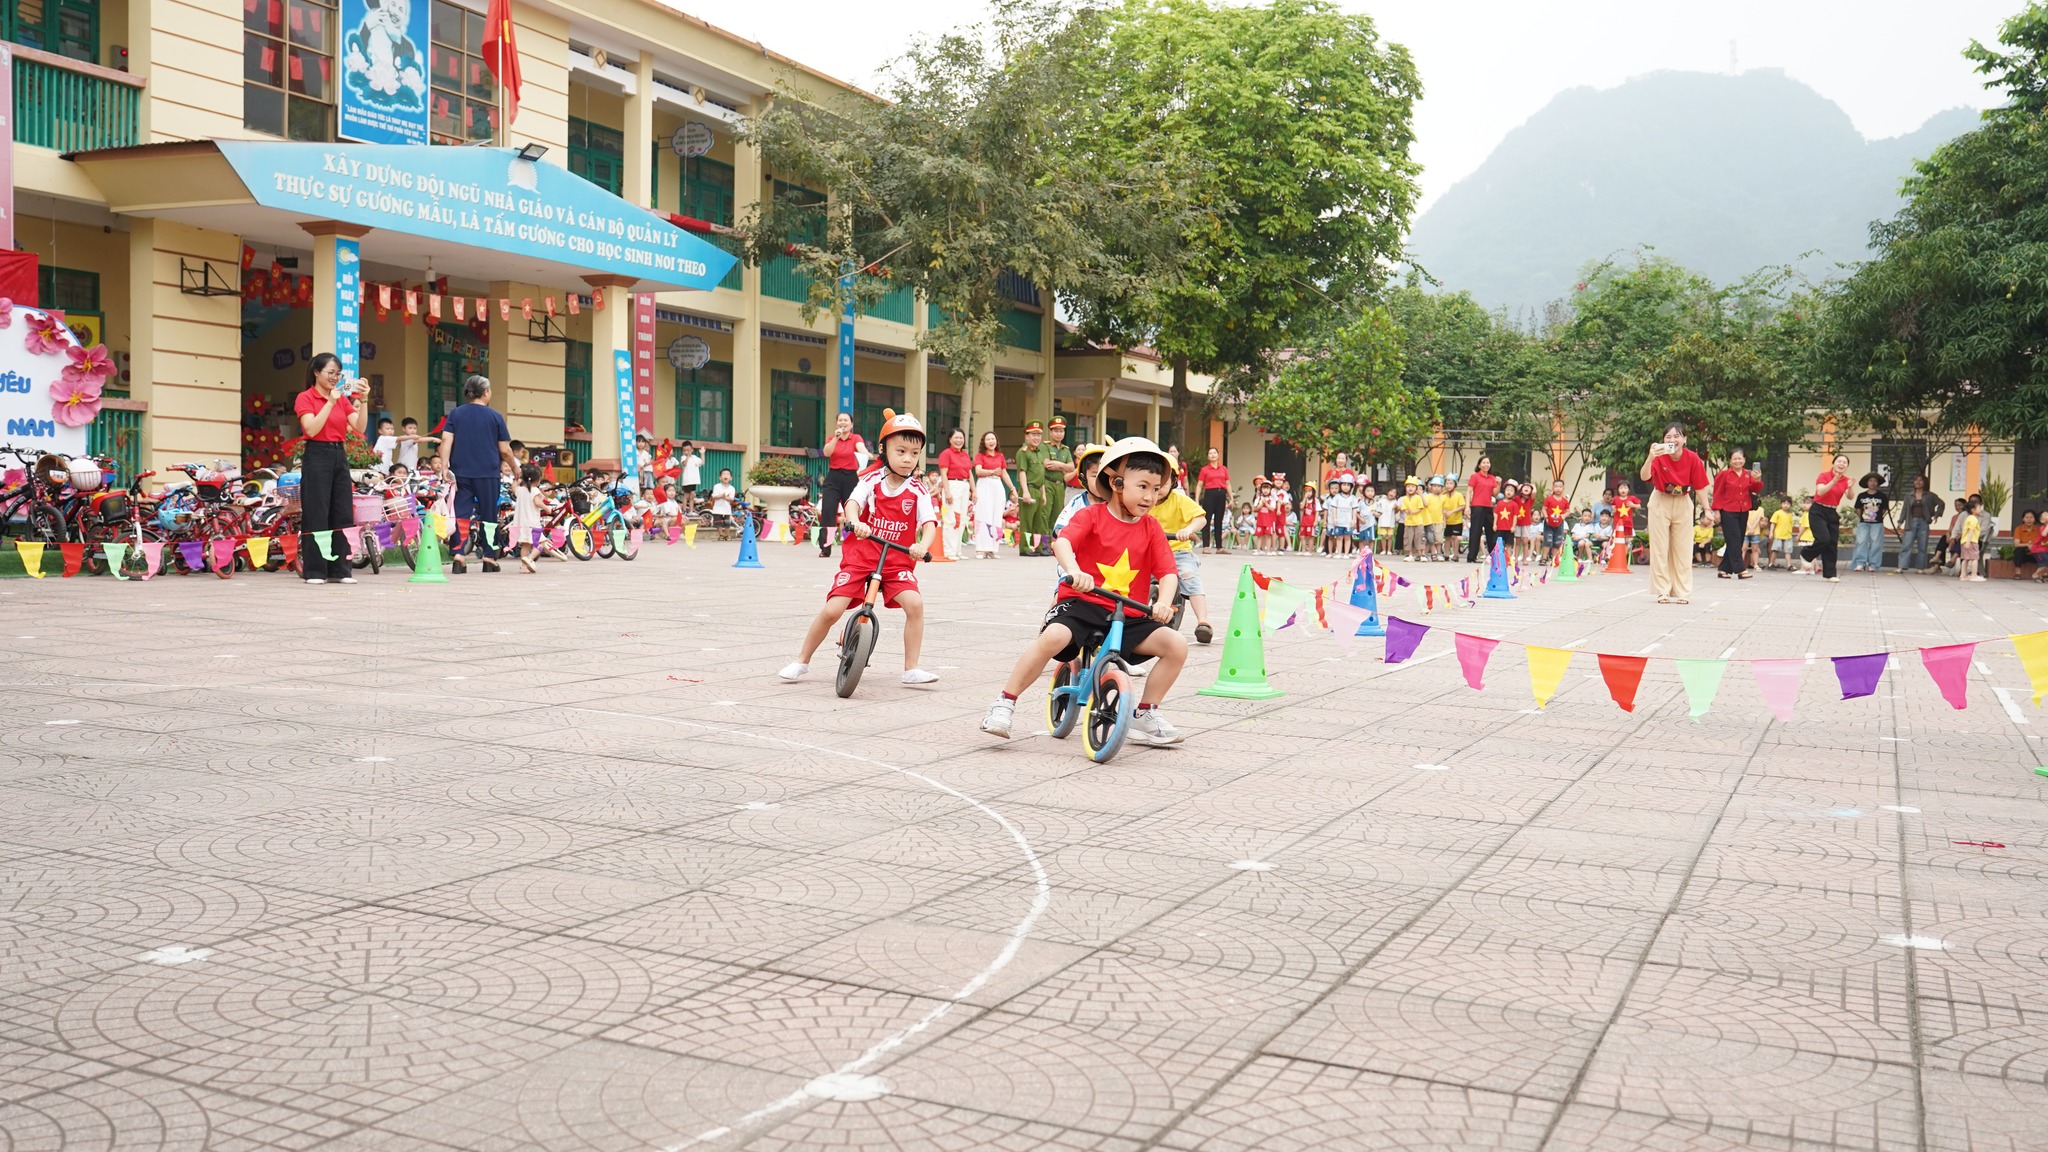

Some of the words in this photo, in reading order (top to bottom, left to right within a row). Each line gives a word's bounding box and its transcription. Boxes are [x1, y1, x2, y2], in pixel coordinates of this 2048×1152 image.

[323, 152, 362, 178] XÂY
[366, 164, 413, 189] DỰNG
[416, 172, 445, 196] ĐỘI
[448, 182, 481, 204] NGŨ
[484, 189, 515, 212] NHÀ
[518, 196, 553, 220] GIÁO
[556, 205, 576, 226] VÀ
[578, 211, 605, 232] CÁN
[608, 217, 625, 242] BỘ
[627, 222, 661, 246] QUẢN
[664, 229, 679, 248] LÝ
[273, 172, 325, 200] THỰC
[328, 184, 353, 208] SỰ
[356, 190, 415, 217] GƯƠNG
[418, 196, 458, 229] MẪU,
[460, 208, 481, 231] LÀ
[484, 212, 516, 239] TẤM
[518, 222, 566, 248] GƯƠNG
[568, 236, 595, 255] CHO
[597, 242, 622, 262] HỌC
[624, 248, 653, 267] SINH
[655, 253, 675, 271] NOI
[678, 259, 707, 277] THEO
[8, 418, 55, 438] NAM
[868, 513, 908, 532] Emirates
[879, 527, 901, 541] BETTER
